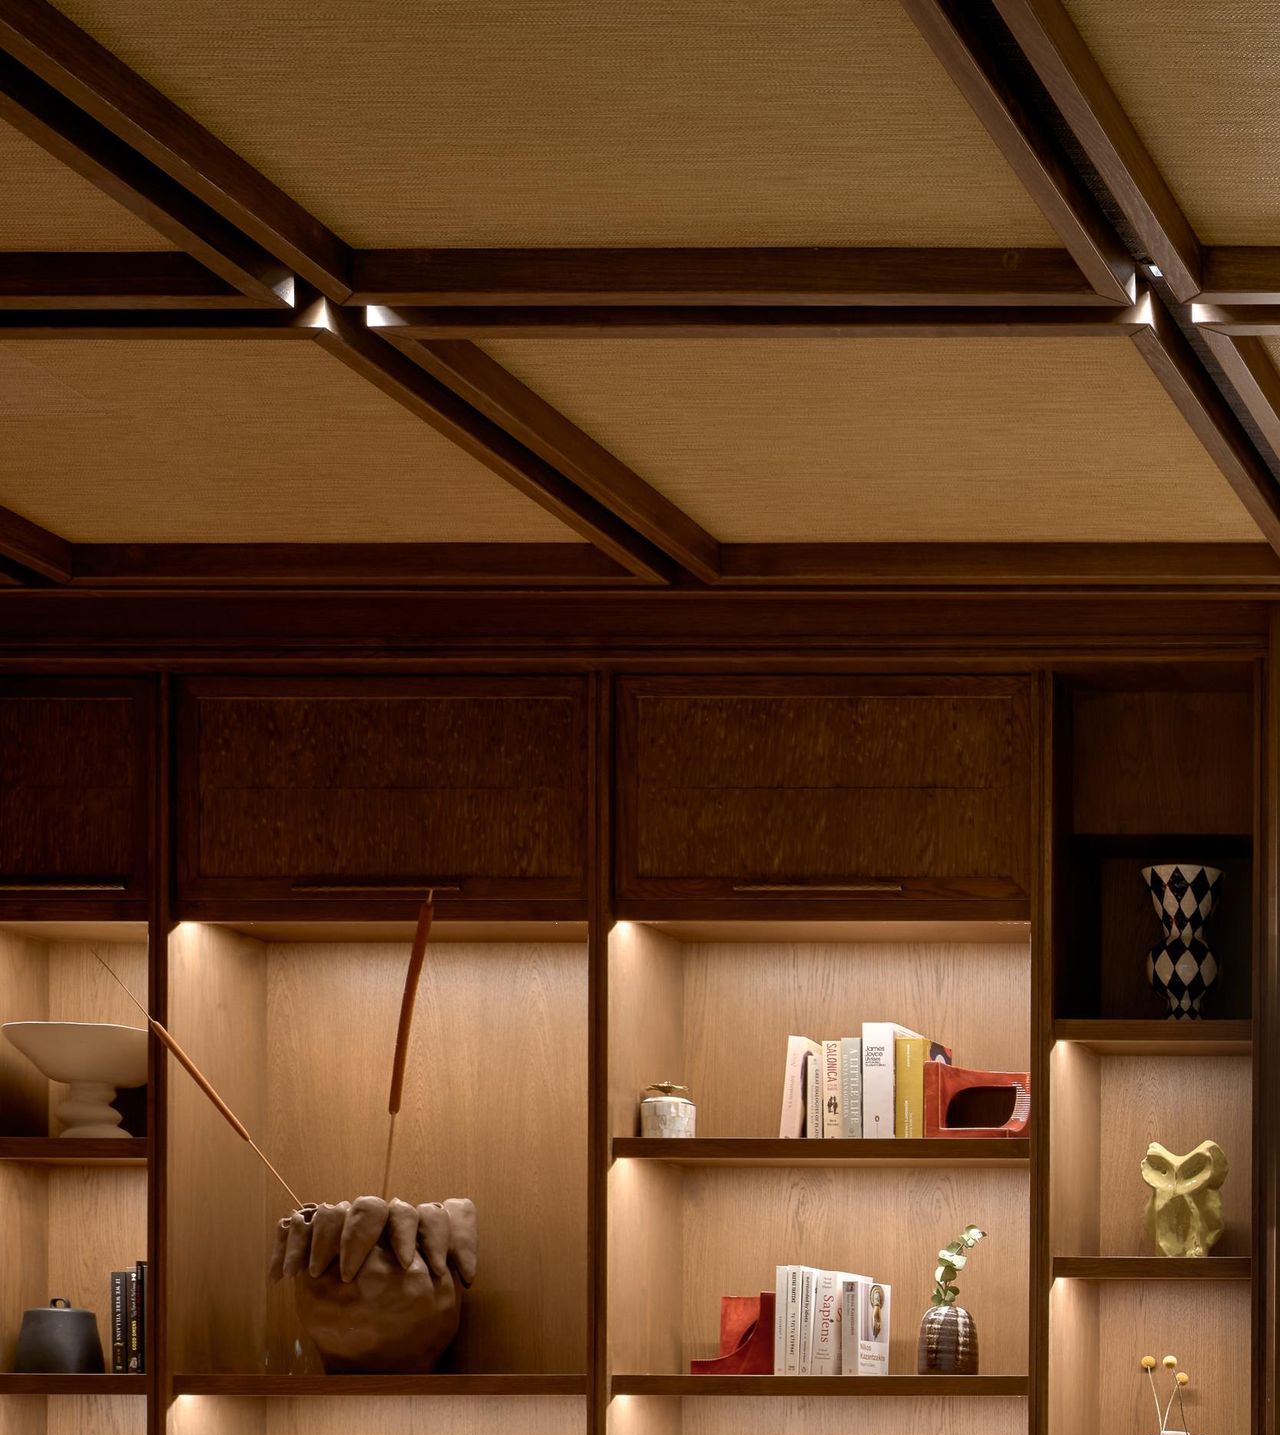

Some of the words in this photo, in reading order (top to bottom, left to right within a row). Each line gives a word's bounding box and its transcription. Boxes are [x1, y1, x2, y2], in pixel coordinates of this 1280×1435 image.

[826, 1043, 838, 1083] SALONICA
[850, 1058, 859, 1096] LITTLE
[850, 1100, 860, 1124] LIFE
[115, 1285, 121, 1295] WE
[820, 1294, 835, 1343] Sapiens
